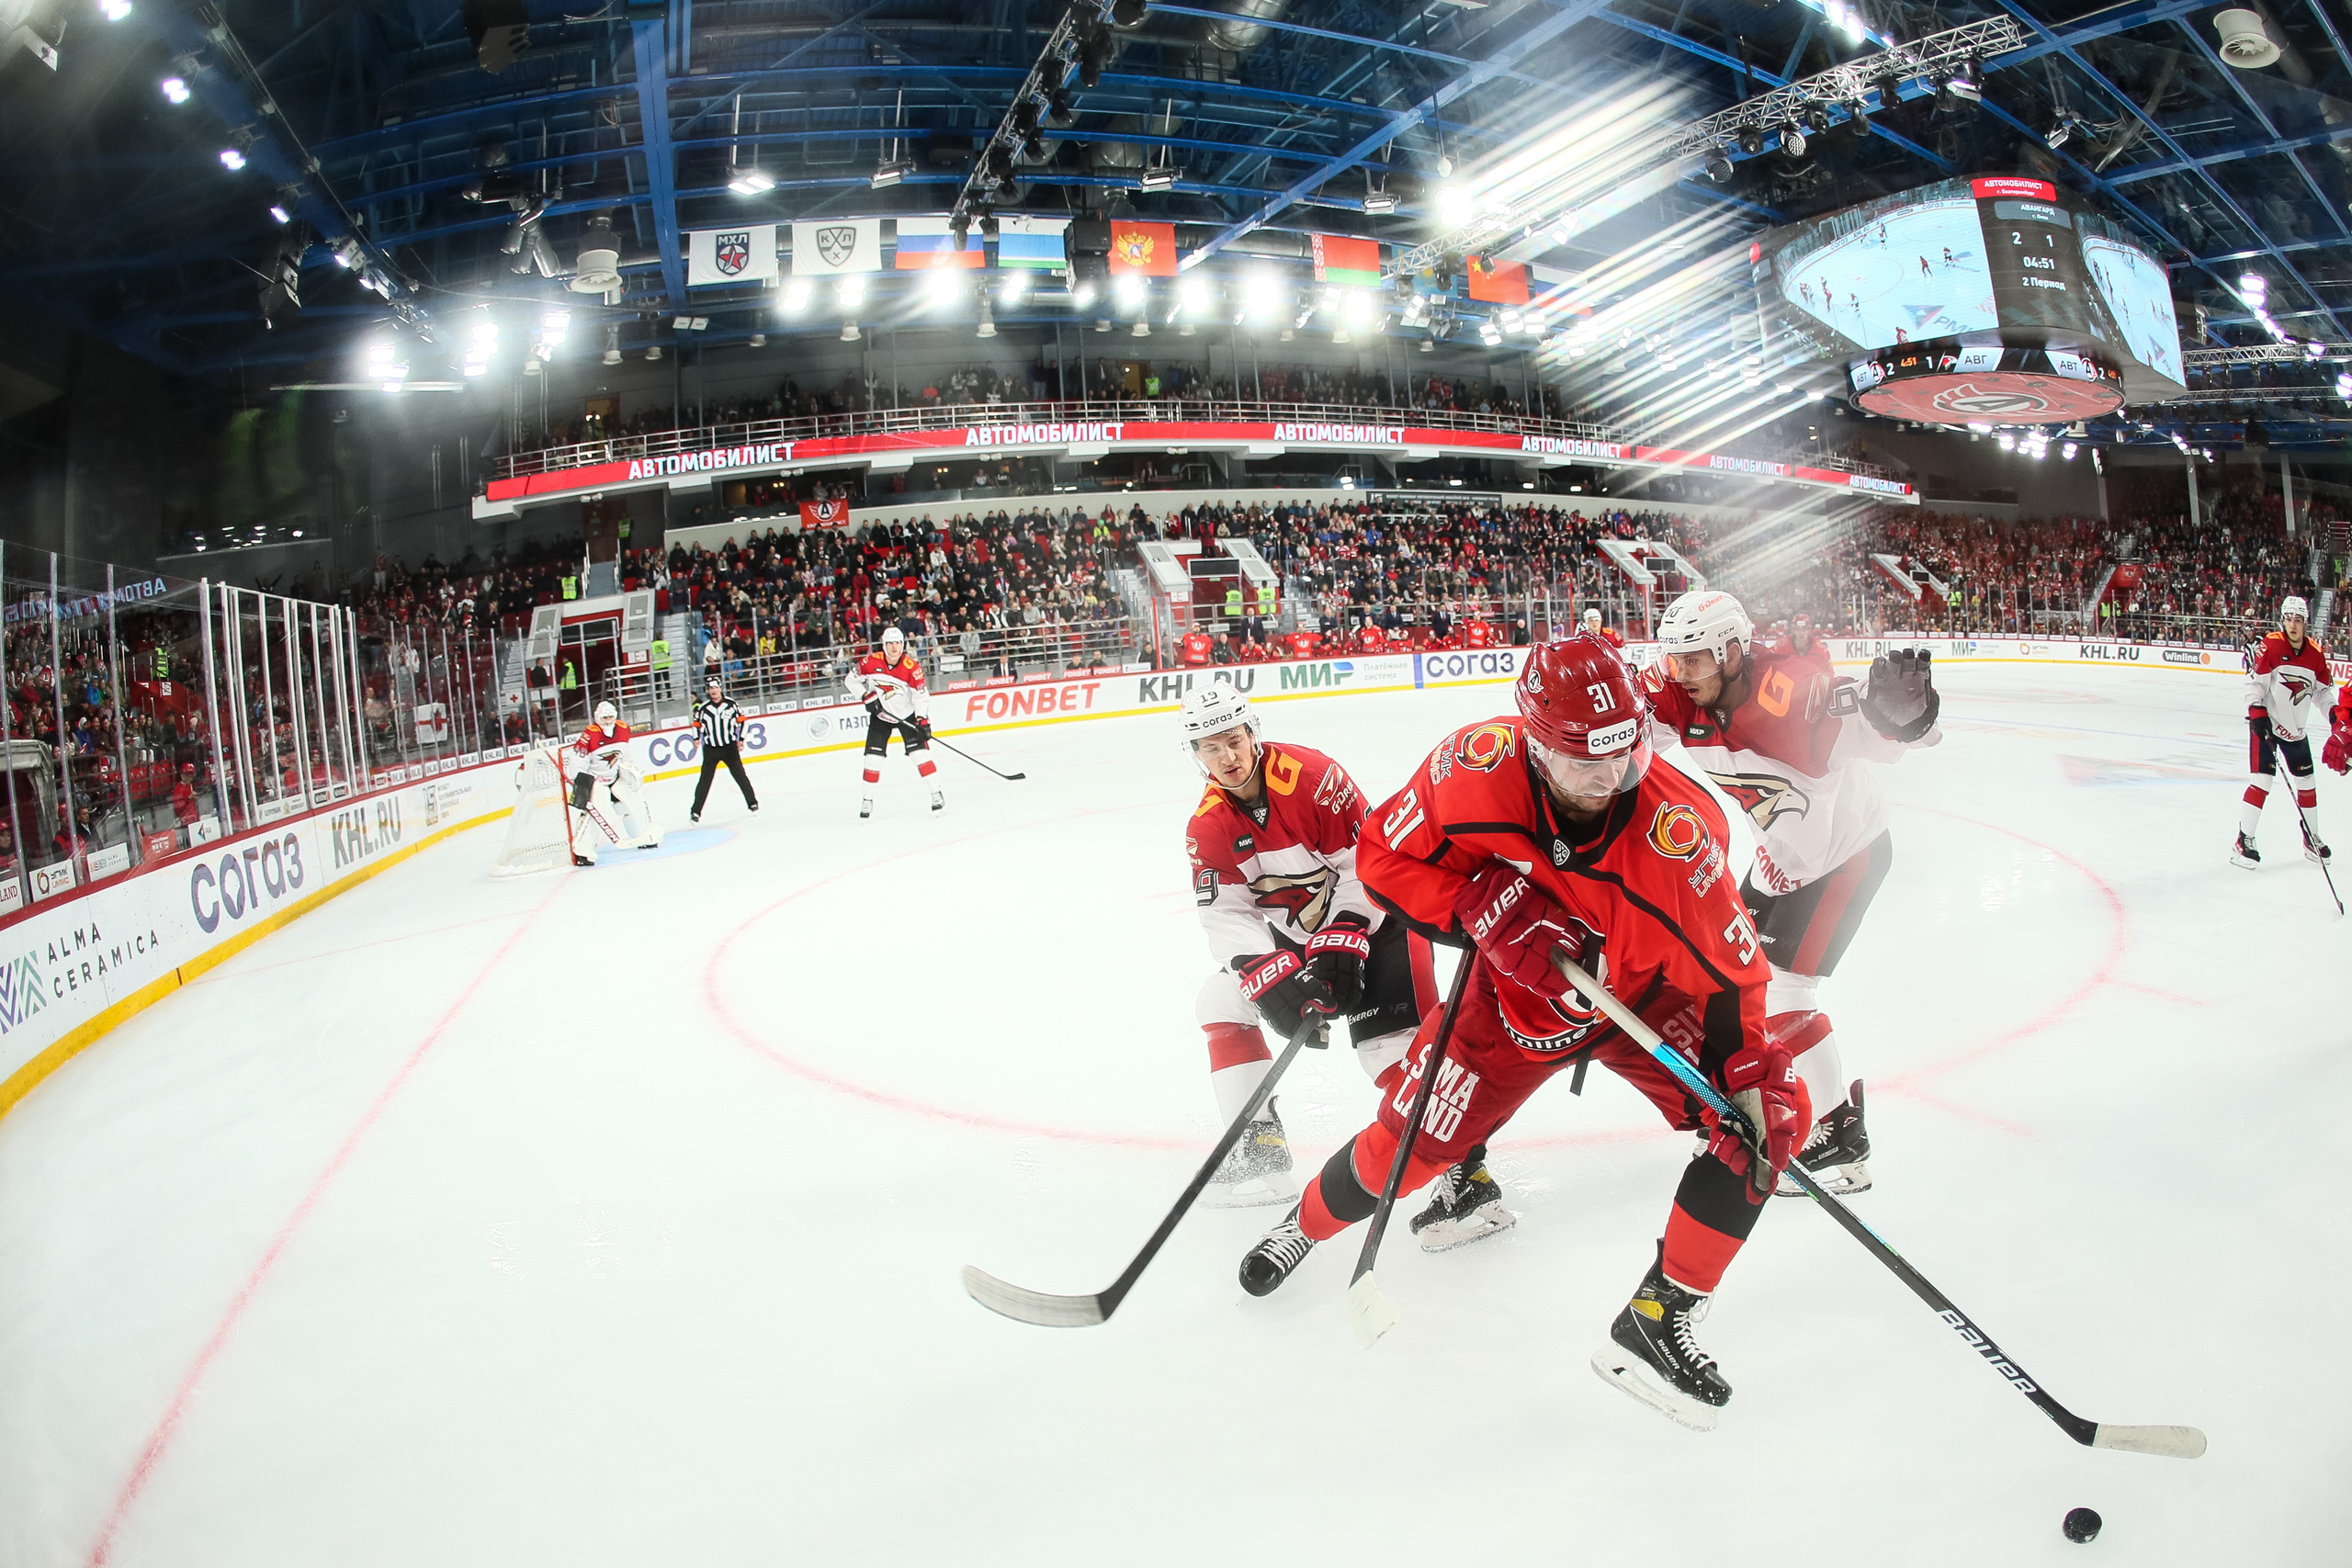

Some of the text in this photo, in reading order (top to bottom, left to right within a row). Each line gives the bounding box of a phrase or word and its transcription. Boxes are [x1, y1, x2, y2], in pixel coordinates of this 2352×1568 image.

[1984, 179, 2043, 190] АВТОМОБИЛИСТ
[2020, 204, 2055, 217] АВАНГАРД
[718, 233, 748, 246] МХЛ
[2011, 231, 2053, 248] 2 1
[2023, 256, 2055, 271] 04:51
[2022, 276, 2066, 292] 2 Период
[1926, 355, 1934, 369] 1
[1964, 355, 1988, 366] АВГ
[2060, 360, 2078, 372] АВТ
[1886, 362, 1895, 377] 2
[2098, 367, 2106, 380] 2
[965, 423, 1125, 447] АВТОМОБИЛИСТ
[1273, 423, 1406, 446] АВТОМОБИЛИСТ
[1521, 435, 1623, 458] АВТОМОБИЛИСТ
[628, 442, 796, 480] АВТОМОБИЛИСТ
[1709, 455, 1785, 477] АВТОМОБИЛИСТ
[1849, 474, 1906, 495] АВТОМОБИЛИСТ
[1717, 626, 1735, 638] CCM
[1846, 640, 1892, 659] KHL.RU
[1951, 641, 1977, 657] МИР
[2080, 644, 2141, 660] KHL.RU
[2165, 651, 2199, 663] Winline
[1093, 666, 1122, 675] FONBET
[1426, 652, 1515, 678] согаз
[986, 676, 1015, 686] FONBET
[1023, 672, 1052, 682] FONBET
[1063, 669, 1091, 679] FONBET
[1280, 661, 1355, 690] МИР
[1364, 671, 1396, 682] система
[949, 681, 978, 690] FONBET
[806, 698, 832, 707] KHL.RU
[966, 682, 1101, 722] FONBET
[1200, 690, 1218, 705] 19
[1587, 682, 1616, 714] 31
[769, 703, 796, 712] KHL.RU
[839, 715, 871, 732] ГАЗП
[1203, 713, 1233, 728] согаз
[649, 722, 767, 767] соз
[1590, 726, 1635, 748] согаз
[590, 807, 620, 844] BAUER
[1383, 787, 1426, 852] 31
[331, 795, 403, 870] KHL.RU
[51, 867, 69, 880] УГМК
[191, 832, 304, 934] согаз
[0, 885, 18, 903] LAND
[1474, 875, 1531, 938] AUER
[48, 922, 102, 965] ALMA
[1310, 933, 1371, 958] BAUE
[53, 930, 160, 998] CERAMICA
[1240, 953, 1294, 1002] AUER
[1348, 1007, 1380, 1026] ENERGY
[1409, 1043, 1481, 1112] SMA
[1656, 1337, 1680, 1371] BAUER
[1936, 1308, 2038, 1395] BAUER
